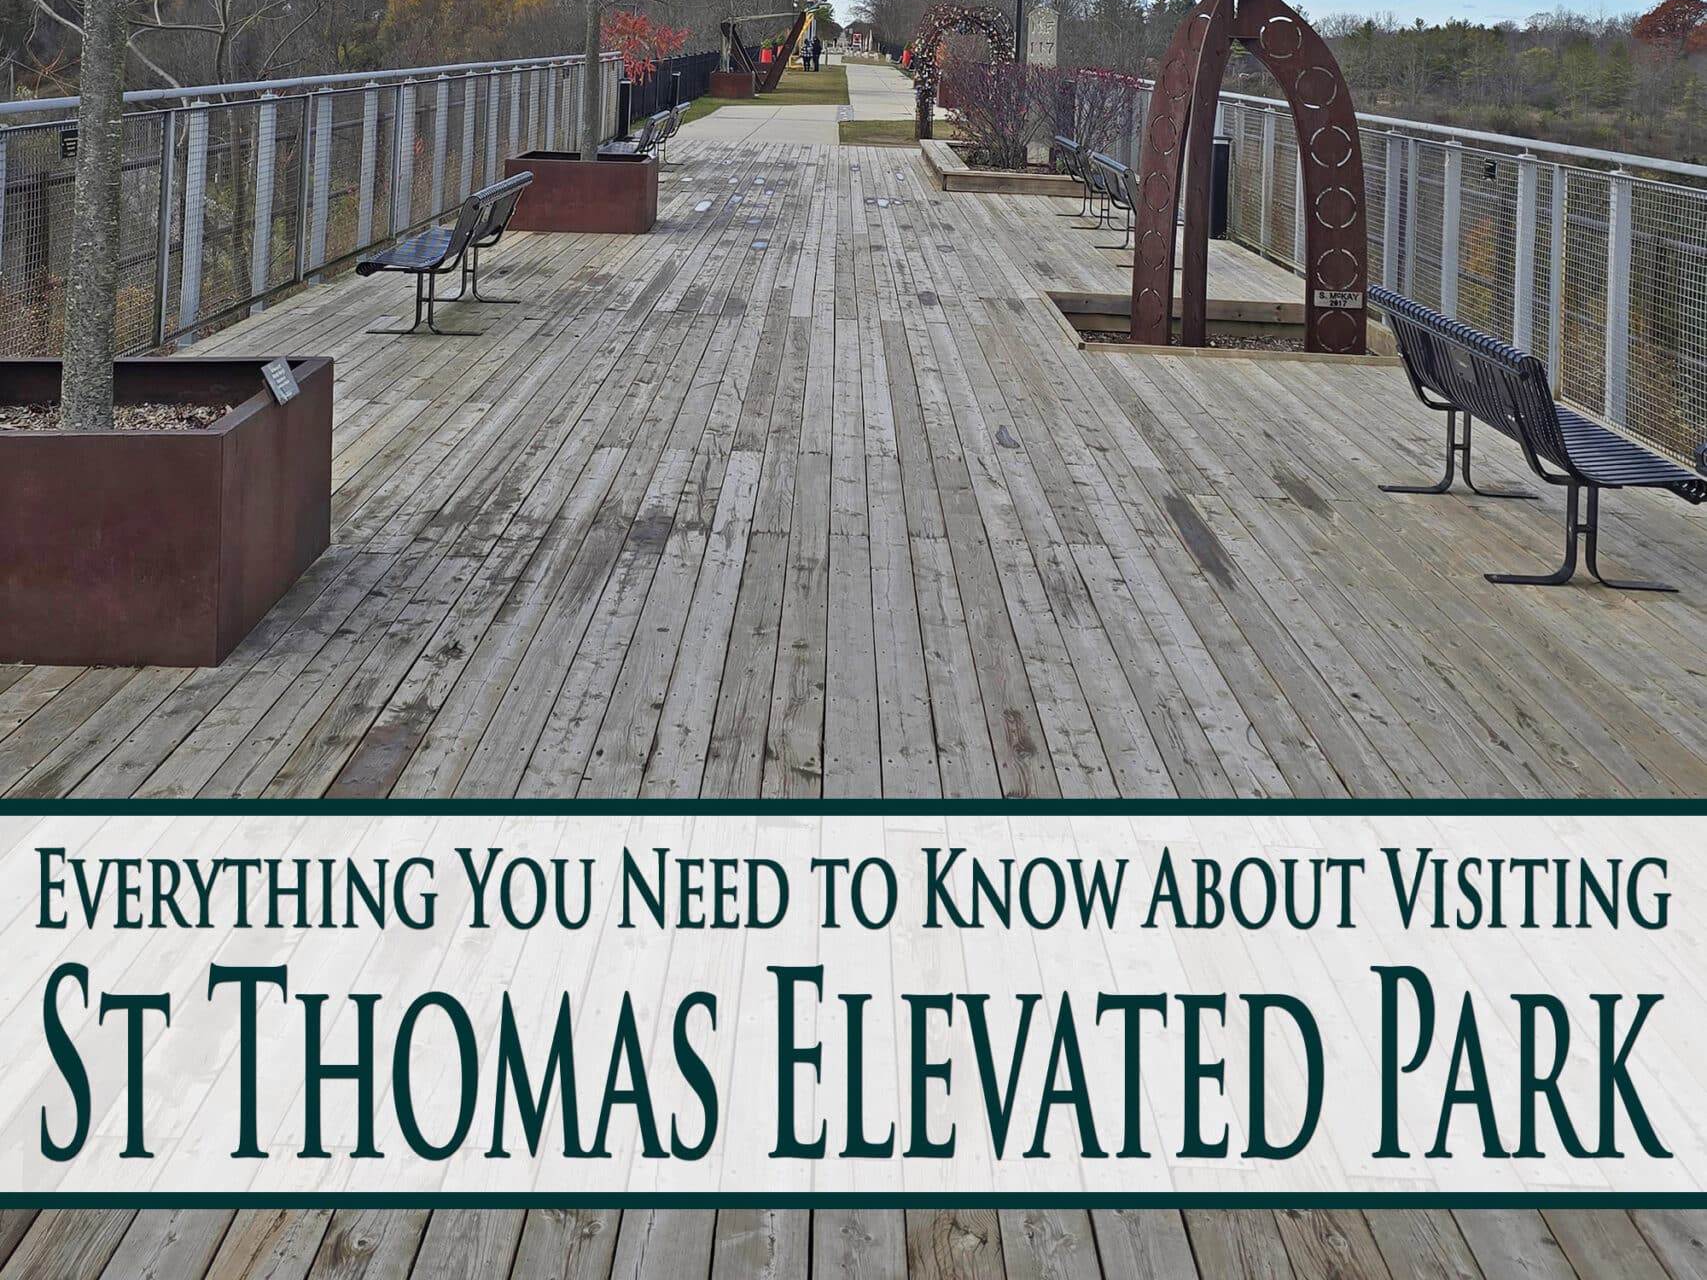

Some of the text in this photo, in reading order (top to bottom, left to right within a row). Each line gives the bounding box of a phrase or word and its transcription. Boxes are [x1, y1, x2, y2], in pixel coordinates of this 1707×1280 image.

[1029, 41, 1055, 55] 117
[1318, 291, 1328, 300] S.
[1329, 299, 1348, 307] 2017
